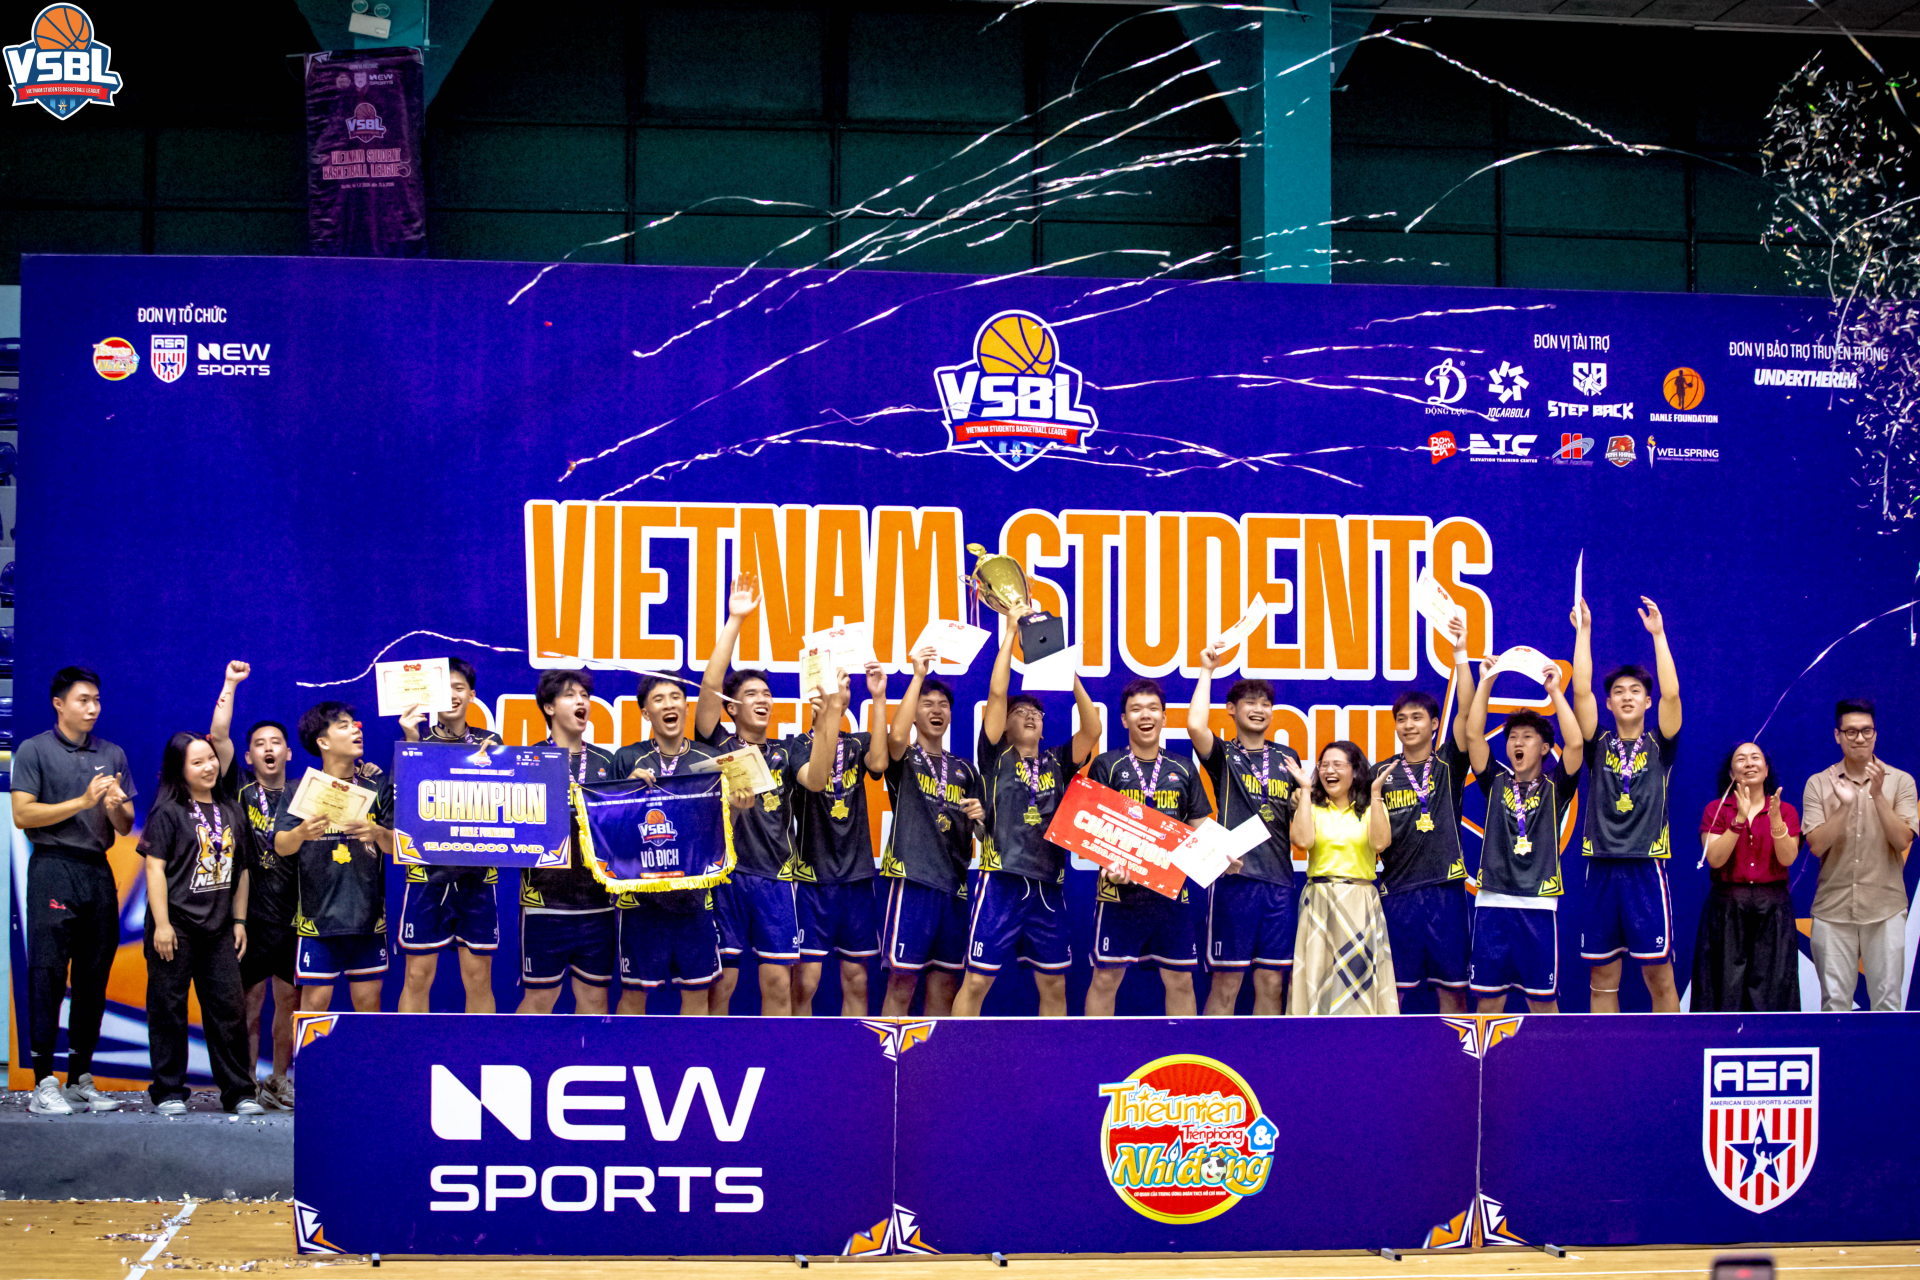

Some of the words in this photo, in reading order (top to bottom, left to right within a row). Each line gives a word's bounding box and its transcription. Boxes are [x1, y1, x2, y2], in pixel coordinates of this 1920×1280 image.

[347, 118, 385, 132] VSBL
[137, 306, 163, 323] ĐƠN
[165, 307, 176, 325] VỊ
[178, 302, 194, 323] TỔ
[194, 305, 227, 323] CHỨC
[154, 338, 185, 349] ASA
[1533, 333, 1558, 349] ĐƠN
[1559, 334, 1570, 352] VỊ
[1571, 332, 1587, 350] TÀI
[1589, 334, 1610, 353] TRỢ
[1729, 341, 1752, 357] ĐƠN
[1754, 342, 1765, 360] VỊ
[1767, 339, 1788, 358] BẢO
[1790, 343, 1810, 361] TRỢ
[198, 343, 271, 361] NEW
[197, 364, 271, 376] SPORTS
[940, 371, 1092, 425] VSBL
[1487, 408, 1530, 418] JOGARBOLA
[1547, 400, 1589, 418] STEP
[1592, 402, 1634, 420] BACK
[1650, 413, 1673, 422] DANLE
[1673, 413, 1719, 423] FOUNDATION
[966, 425, 989, 434] VIETNAM
[989, 425, 1015, 433] STUDENTS
[1015, 425, 1047, 434] BASKETBALL
[1048, 427, 1068, 437] LEAGUE
[1657, 448, 1719, 458] WELLSPRING
[529, 502, 962, 670] VIETNAM
[1003, 510, 1491, 675] STUDENTS
[418, 779, 547, 825] CHAMPION
[639, 823, 676, 836] VSBL
[1073, 809, 1171, 870] CHAMPION
[510, 844, 544, 854] VND
[640, 847, 655, 868] VÔ
[655, 848, 680, 870] ĐỊCH
[405, 922, 414, 939] 13
[898, 943, 905, 958] 7
[973, 941, 983, 958] 16
[1103, 937, 1109, 952] 8
[1214, 941, 1223, 957] 17
[303, 951, 310, 967] 4
[621, 957, 631, 973] 12
[1714, 1061, 1810, 1092] ASA
[431, 1064, 766, 1142] NEW
[430, 1165, 765, 1213] SPORTS
